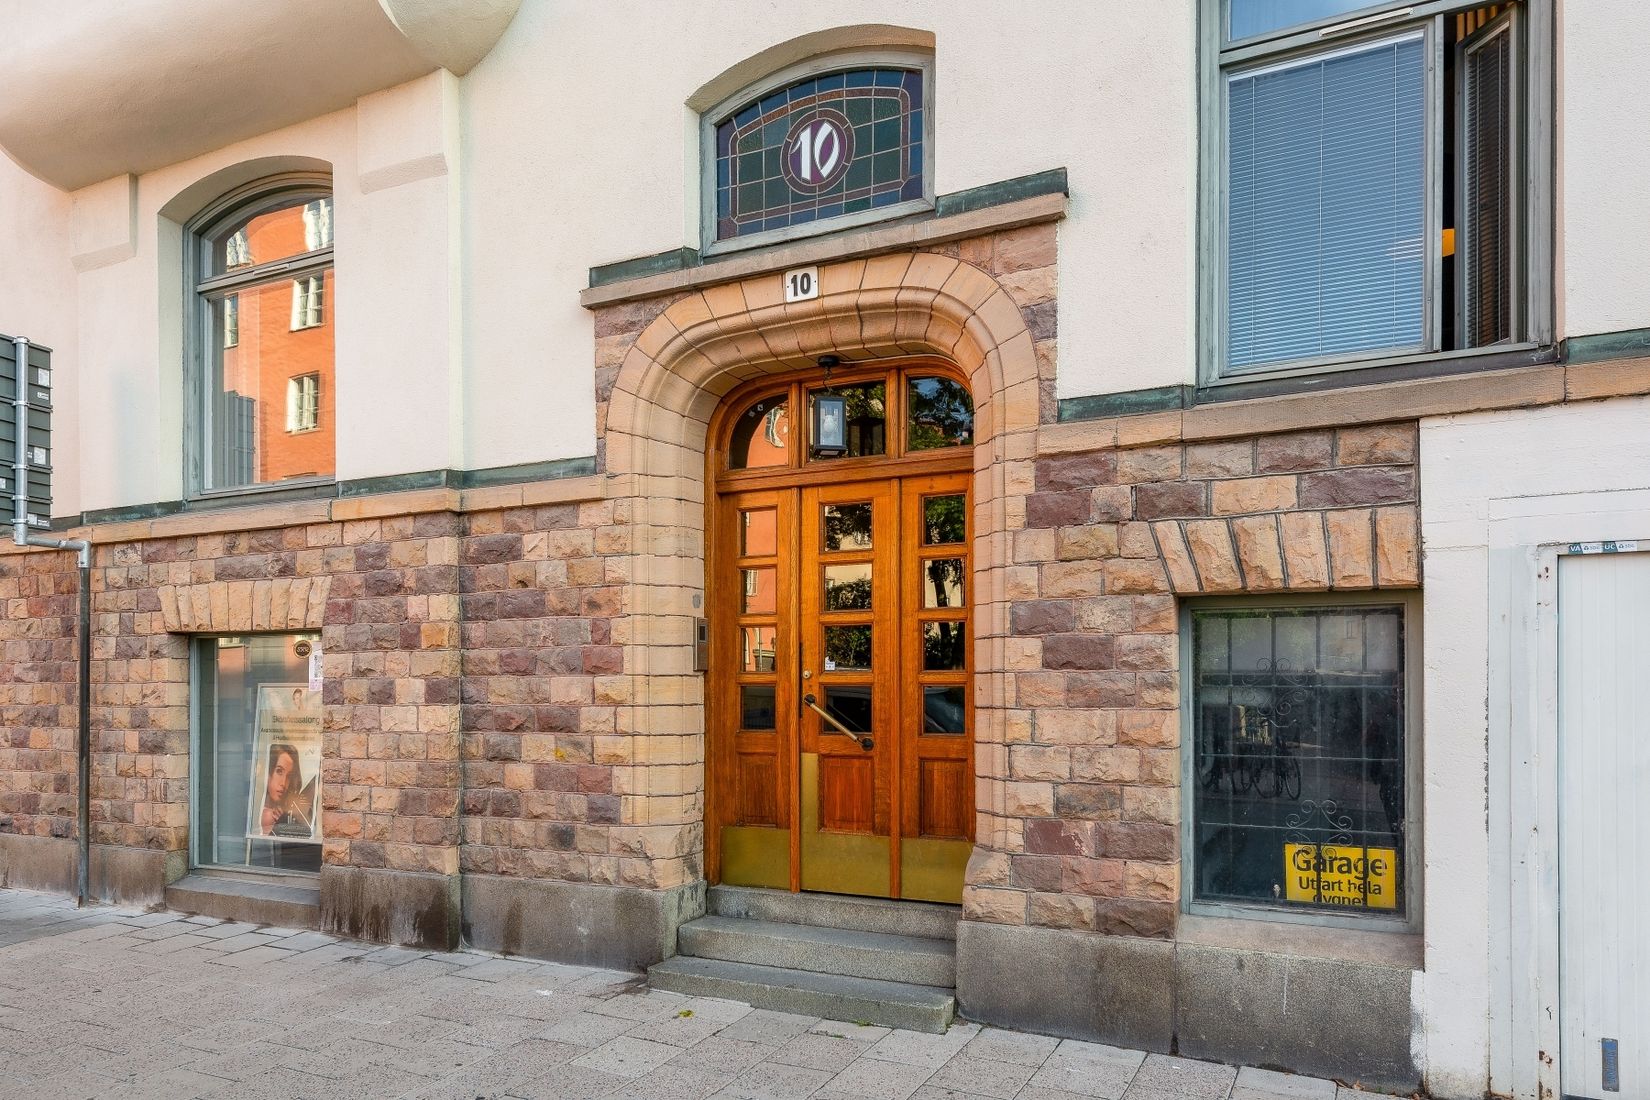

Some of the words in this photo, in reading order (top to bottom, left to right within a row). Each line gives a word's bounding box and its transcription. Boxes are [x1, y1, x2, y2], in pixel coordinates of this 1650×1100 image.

[791, 121, 840, 182] 10
[791, 272, 811, 297] 10
[1293, 849, 1388, 880] Garage
[1298, 876, 1343, 892] Utart
[1348, 879, 1382, 895] hela
[1313, 893, 1366, 906] ygne
